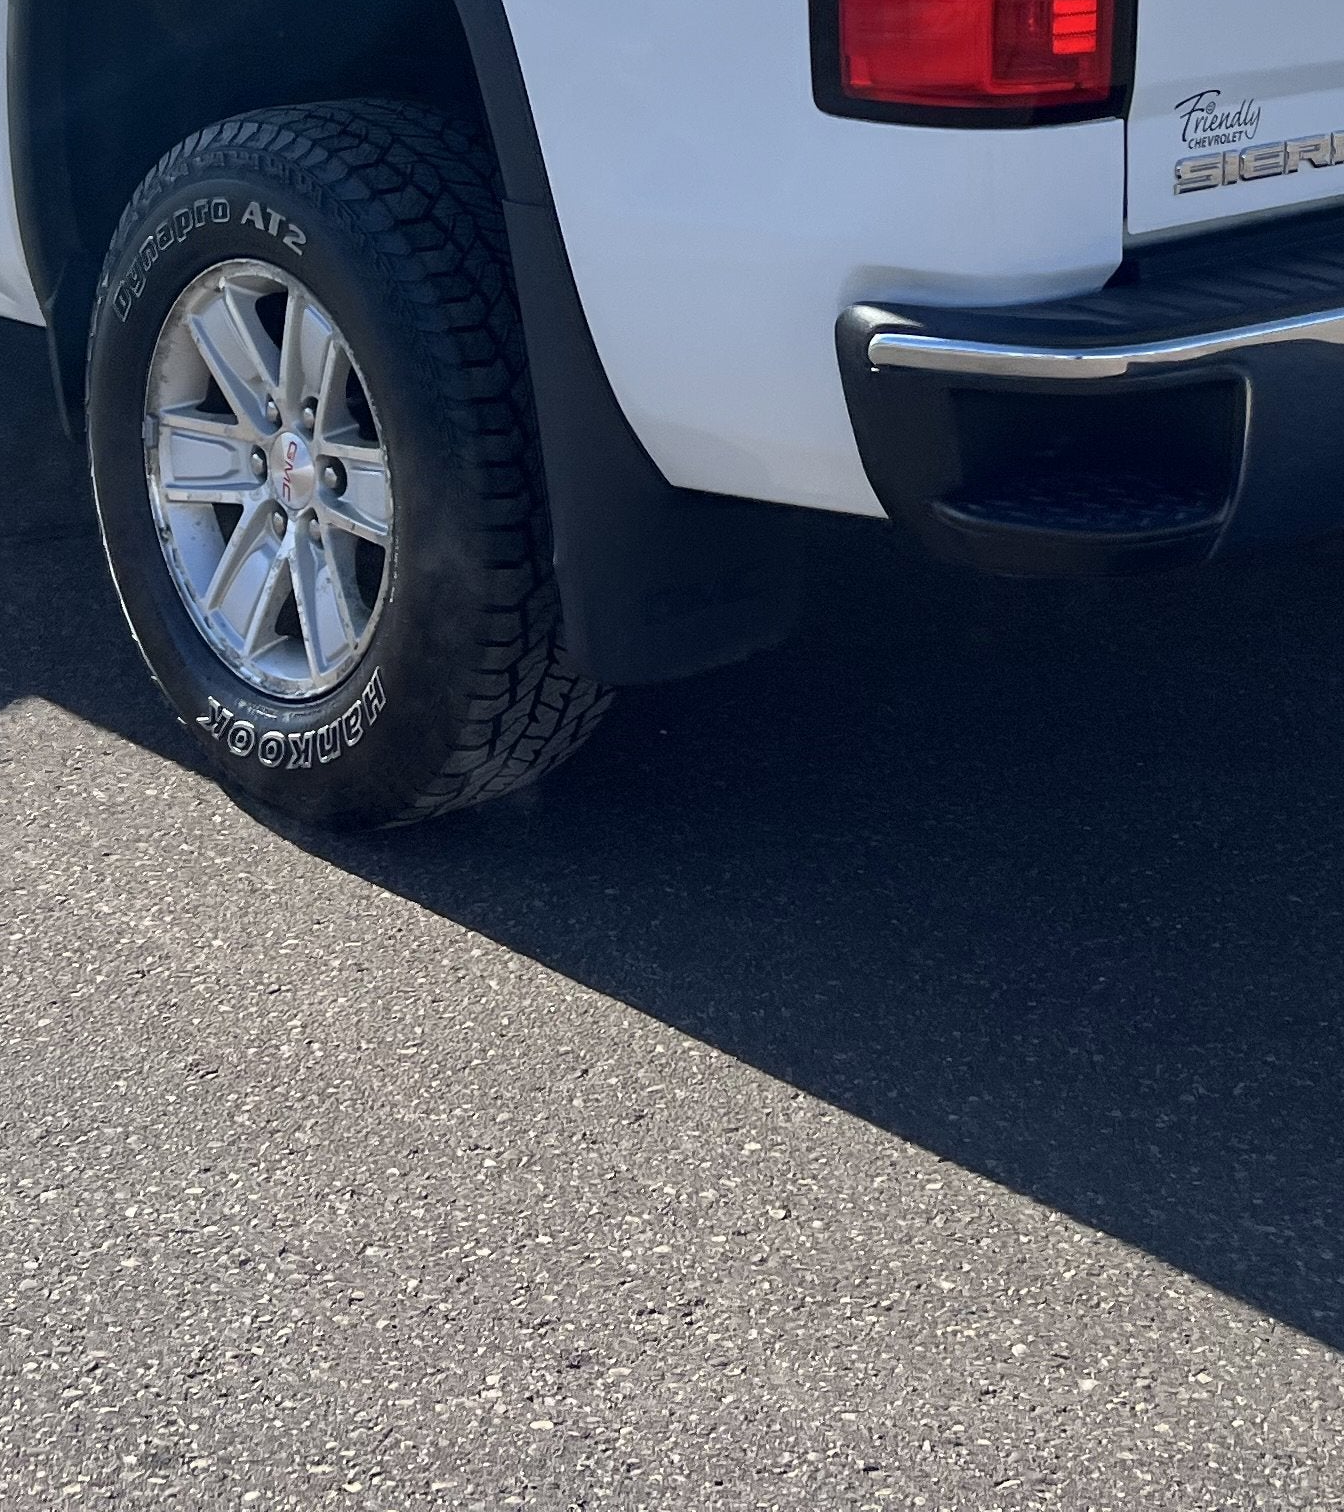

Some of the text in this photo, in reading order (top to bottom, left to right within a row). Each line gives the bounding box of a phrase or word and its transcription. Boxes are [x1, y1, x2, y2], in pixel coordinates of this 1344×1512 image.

[1174, 89, 1261, 142] Friendly
[1187, 131, 1244, 150] CHEVROLET
[240, 201, 307, 256] AT2
[282, 440, 297, 502] GMC
